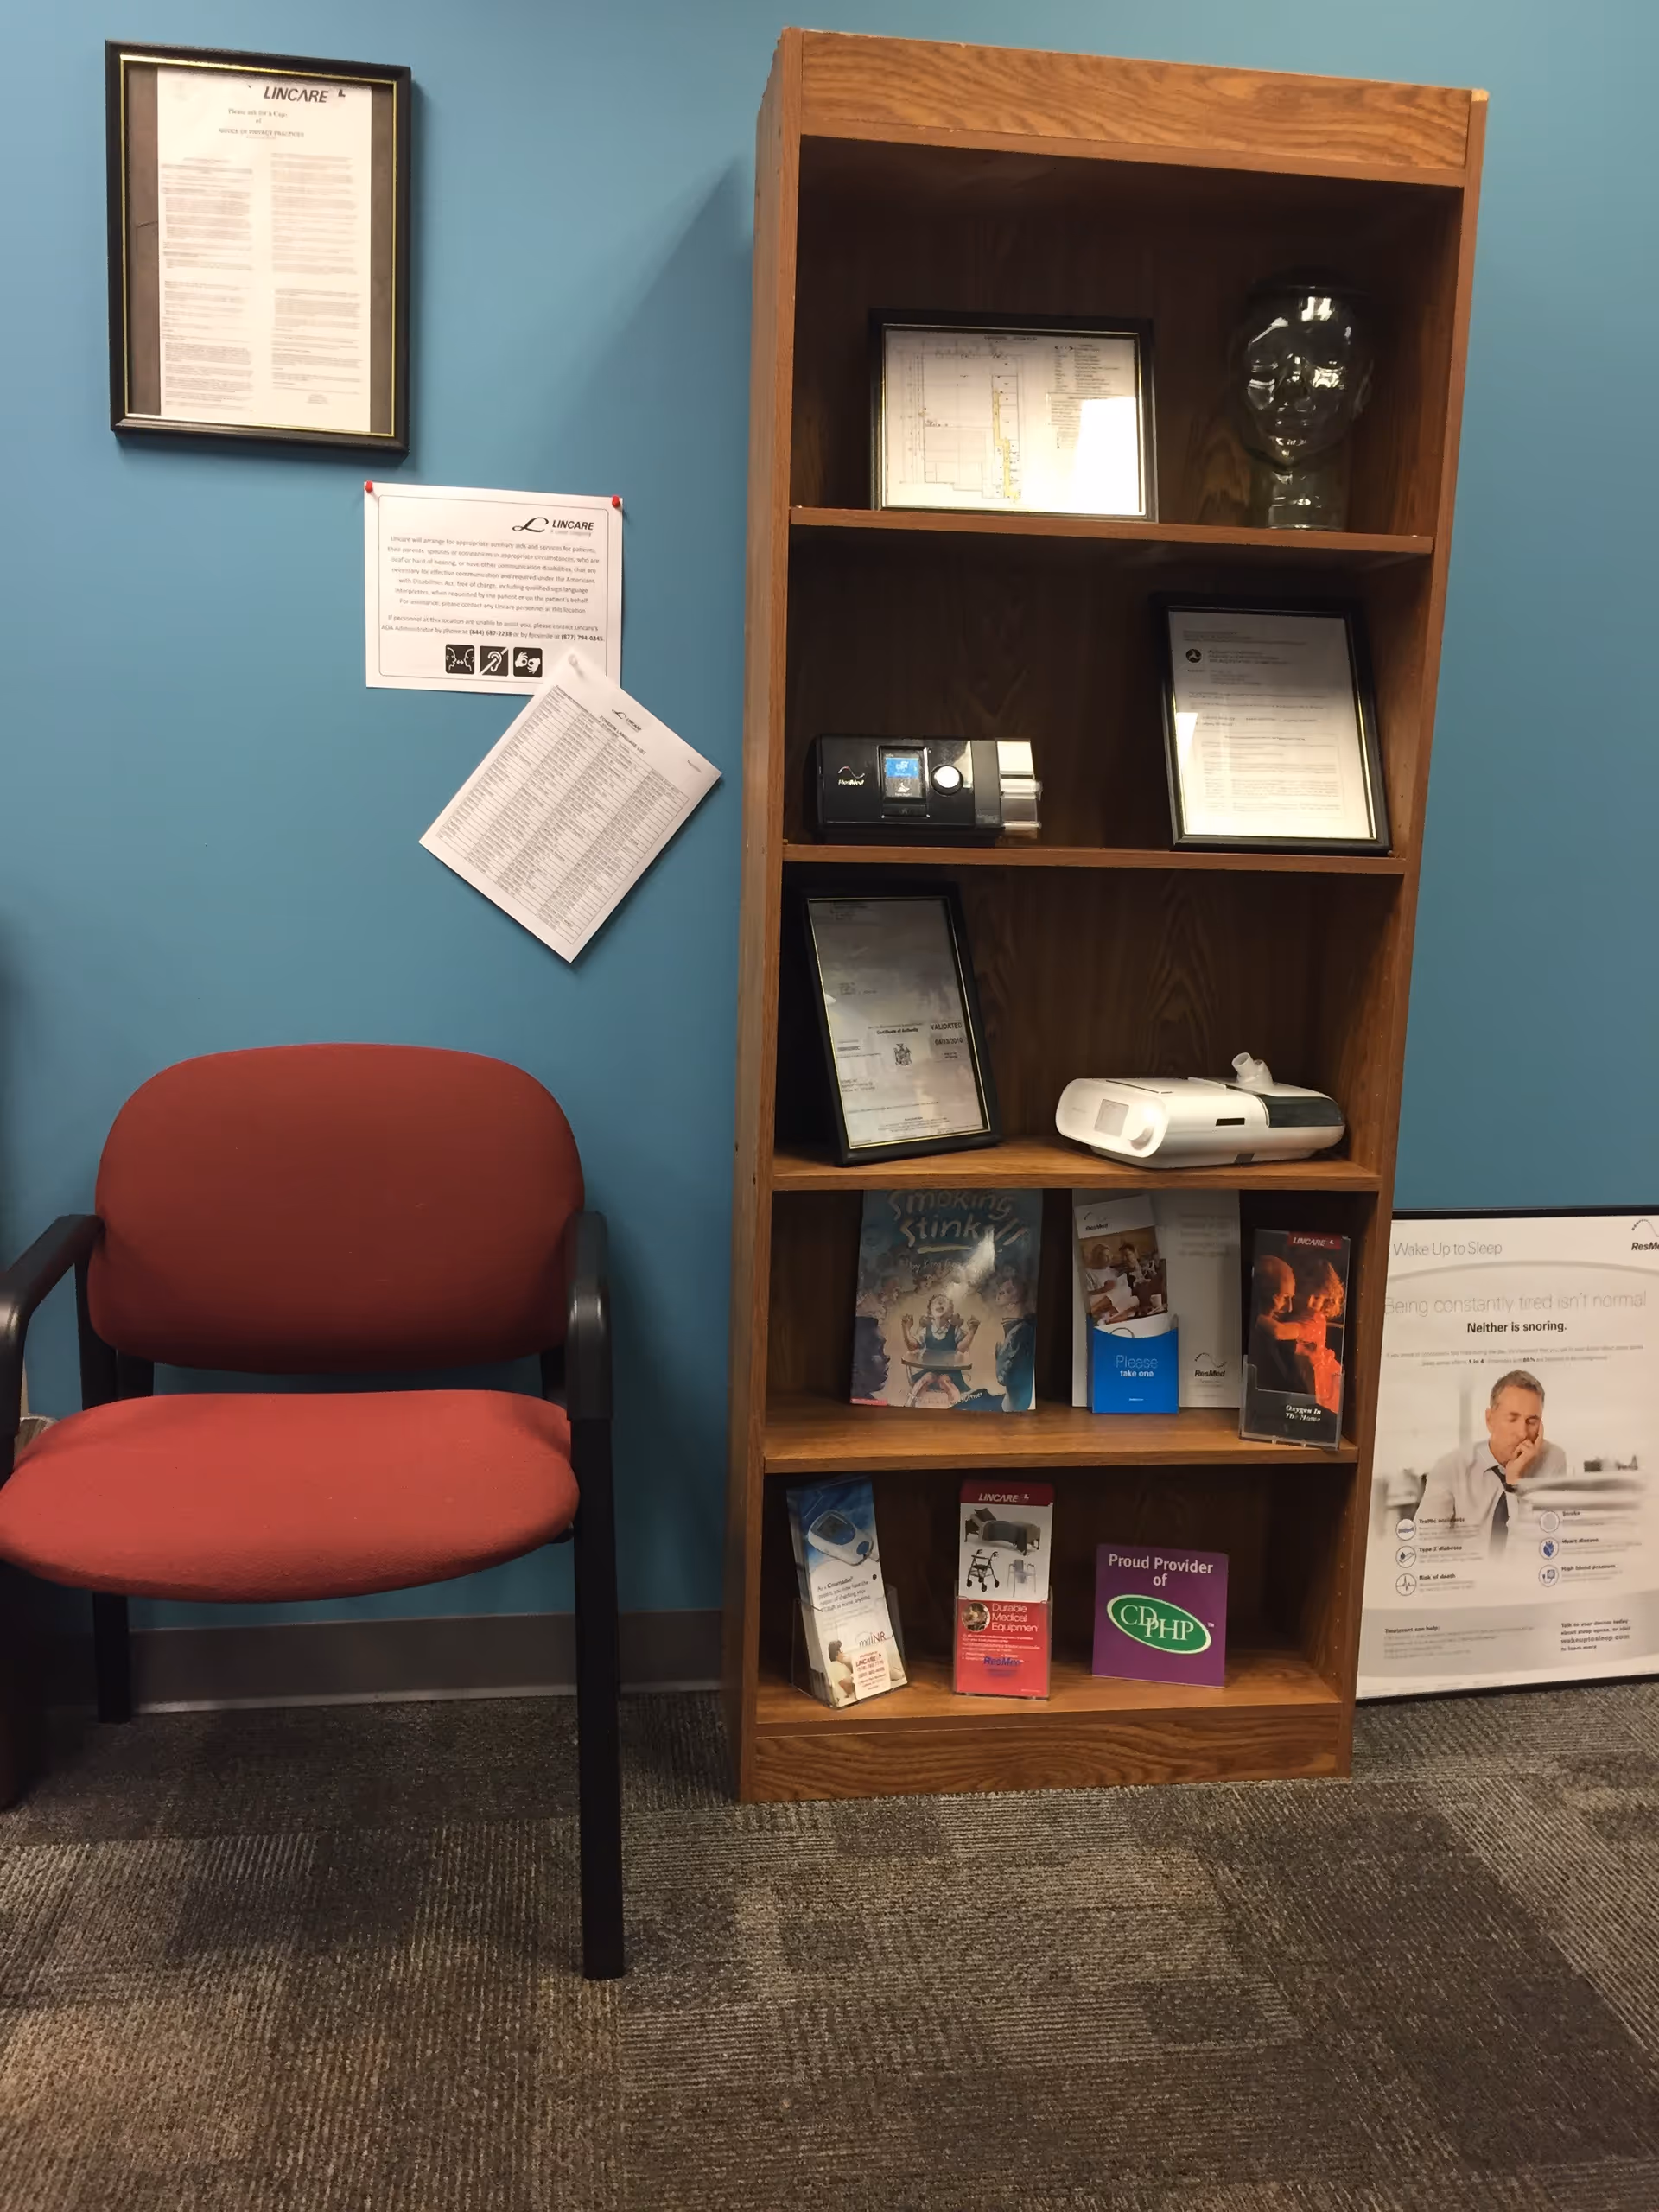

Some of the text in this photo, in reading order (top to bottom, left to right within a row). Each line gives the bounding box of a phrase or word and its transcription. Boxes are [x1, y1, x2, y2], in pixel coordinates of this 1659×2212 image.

[264, 86, 328, 103] LINCARE
[552, 519, 594, 531] LINCARE
[931, 1022, 963, 1031] VALIDATED
[1293, 1236, 1325, 1247] LINCARE
[1394, 1241, 1502, 1257] Wake Up to Sleep
[1434, 1297, 1514, 1313] constantly
[1519, 1294, 1552, 1310] tired
[1467, 1320, 1567, 1333] Neither is snoring.
[1116, 1354, 1158, 1369] Please
[1286, 1405, 1312, 1414] Oxygen
[978, 1493, 1019, 1503] LINCARE
[1109, 1554, 1213, 1573] Proud Provider
[1153, 1573, 1168, 1586] of
[992, 1604, 1027, 1612] Durable
[992, 1613, 1027, 1622] Medical
[1120, 1605, 1194, 1641] CDPHP
